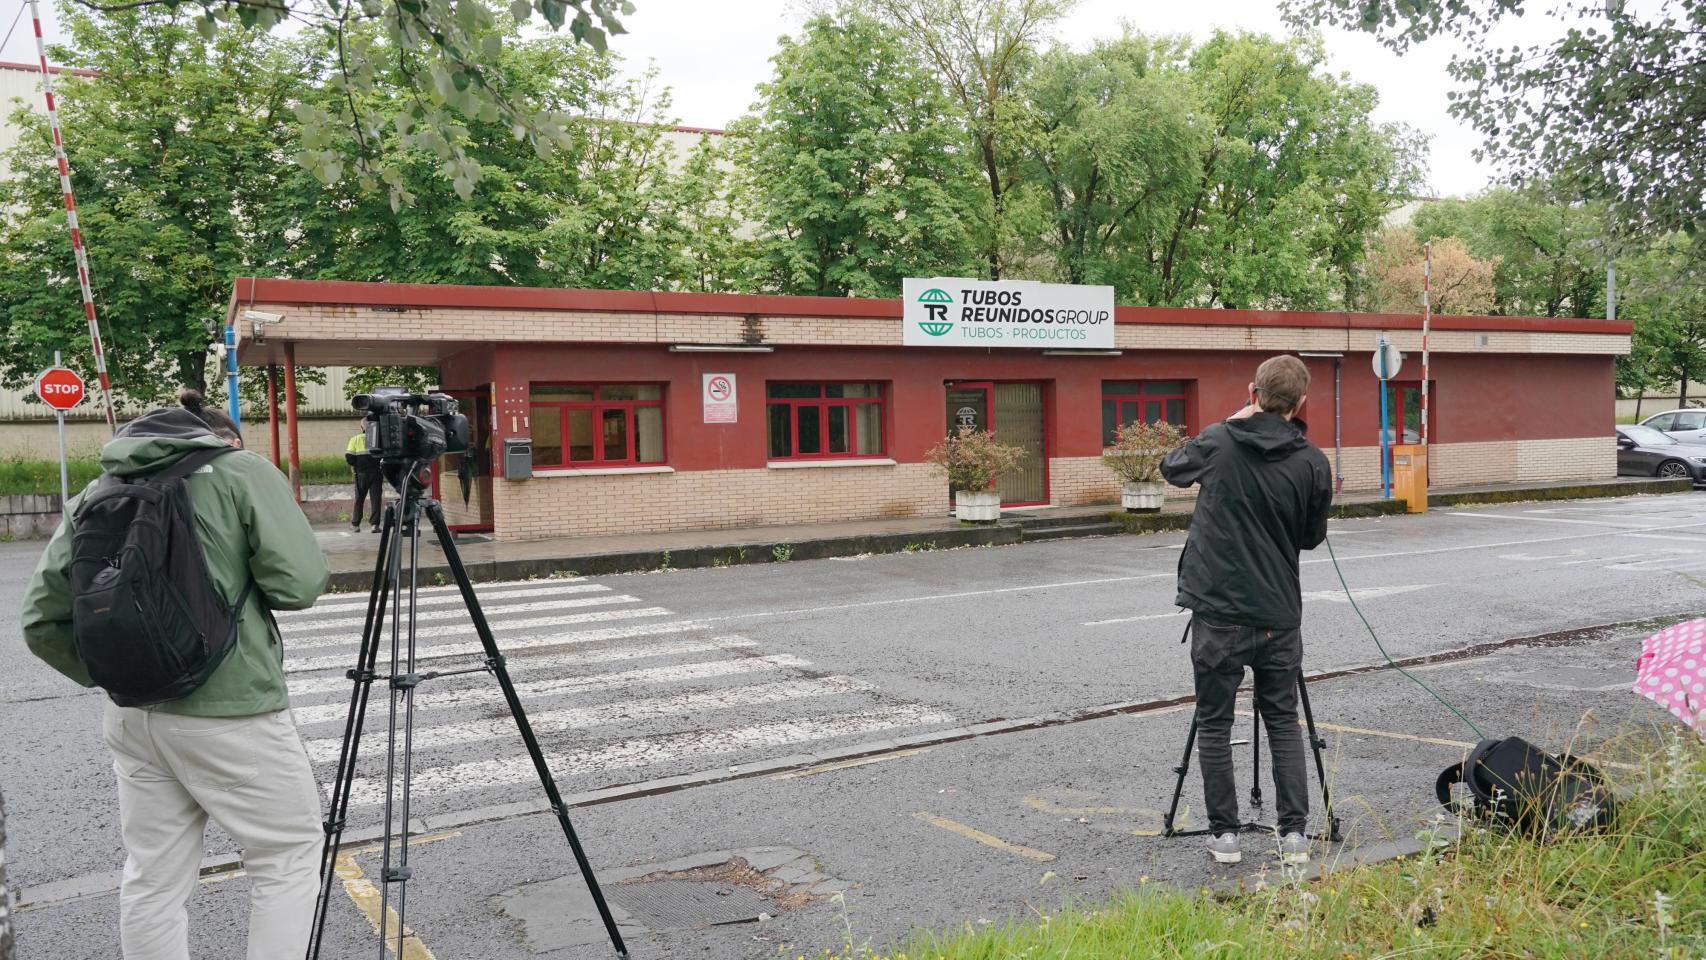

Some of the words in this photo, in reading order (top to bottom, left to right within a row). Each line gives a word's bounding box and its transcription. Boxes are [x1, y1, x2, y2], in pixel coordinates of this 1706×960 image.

[961, 289, 1022, 306] TUBOS
[961, 327, 1003, 338] TUBOS
[1012, 328, 1087, 340] PRODUCTOS
[44, 384, 79, 394] STOP
